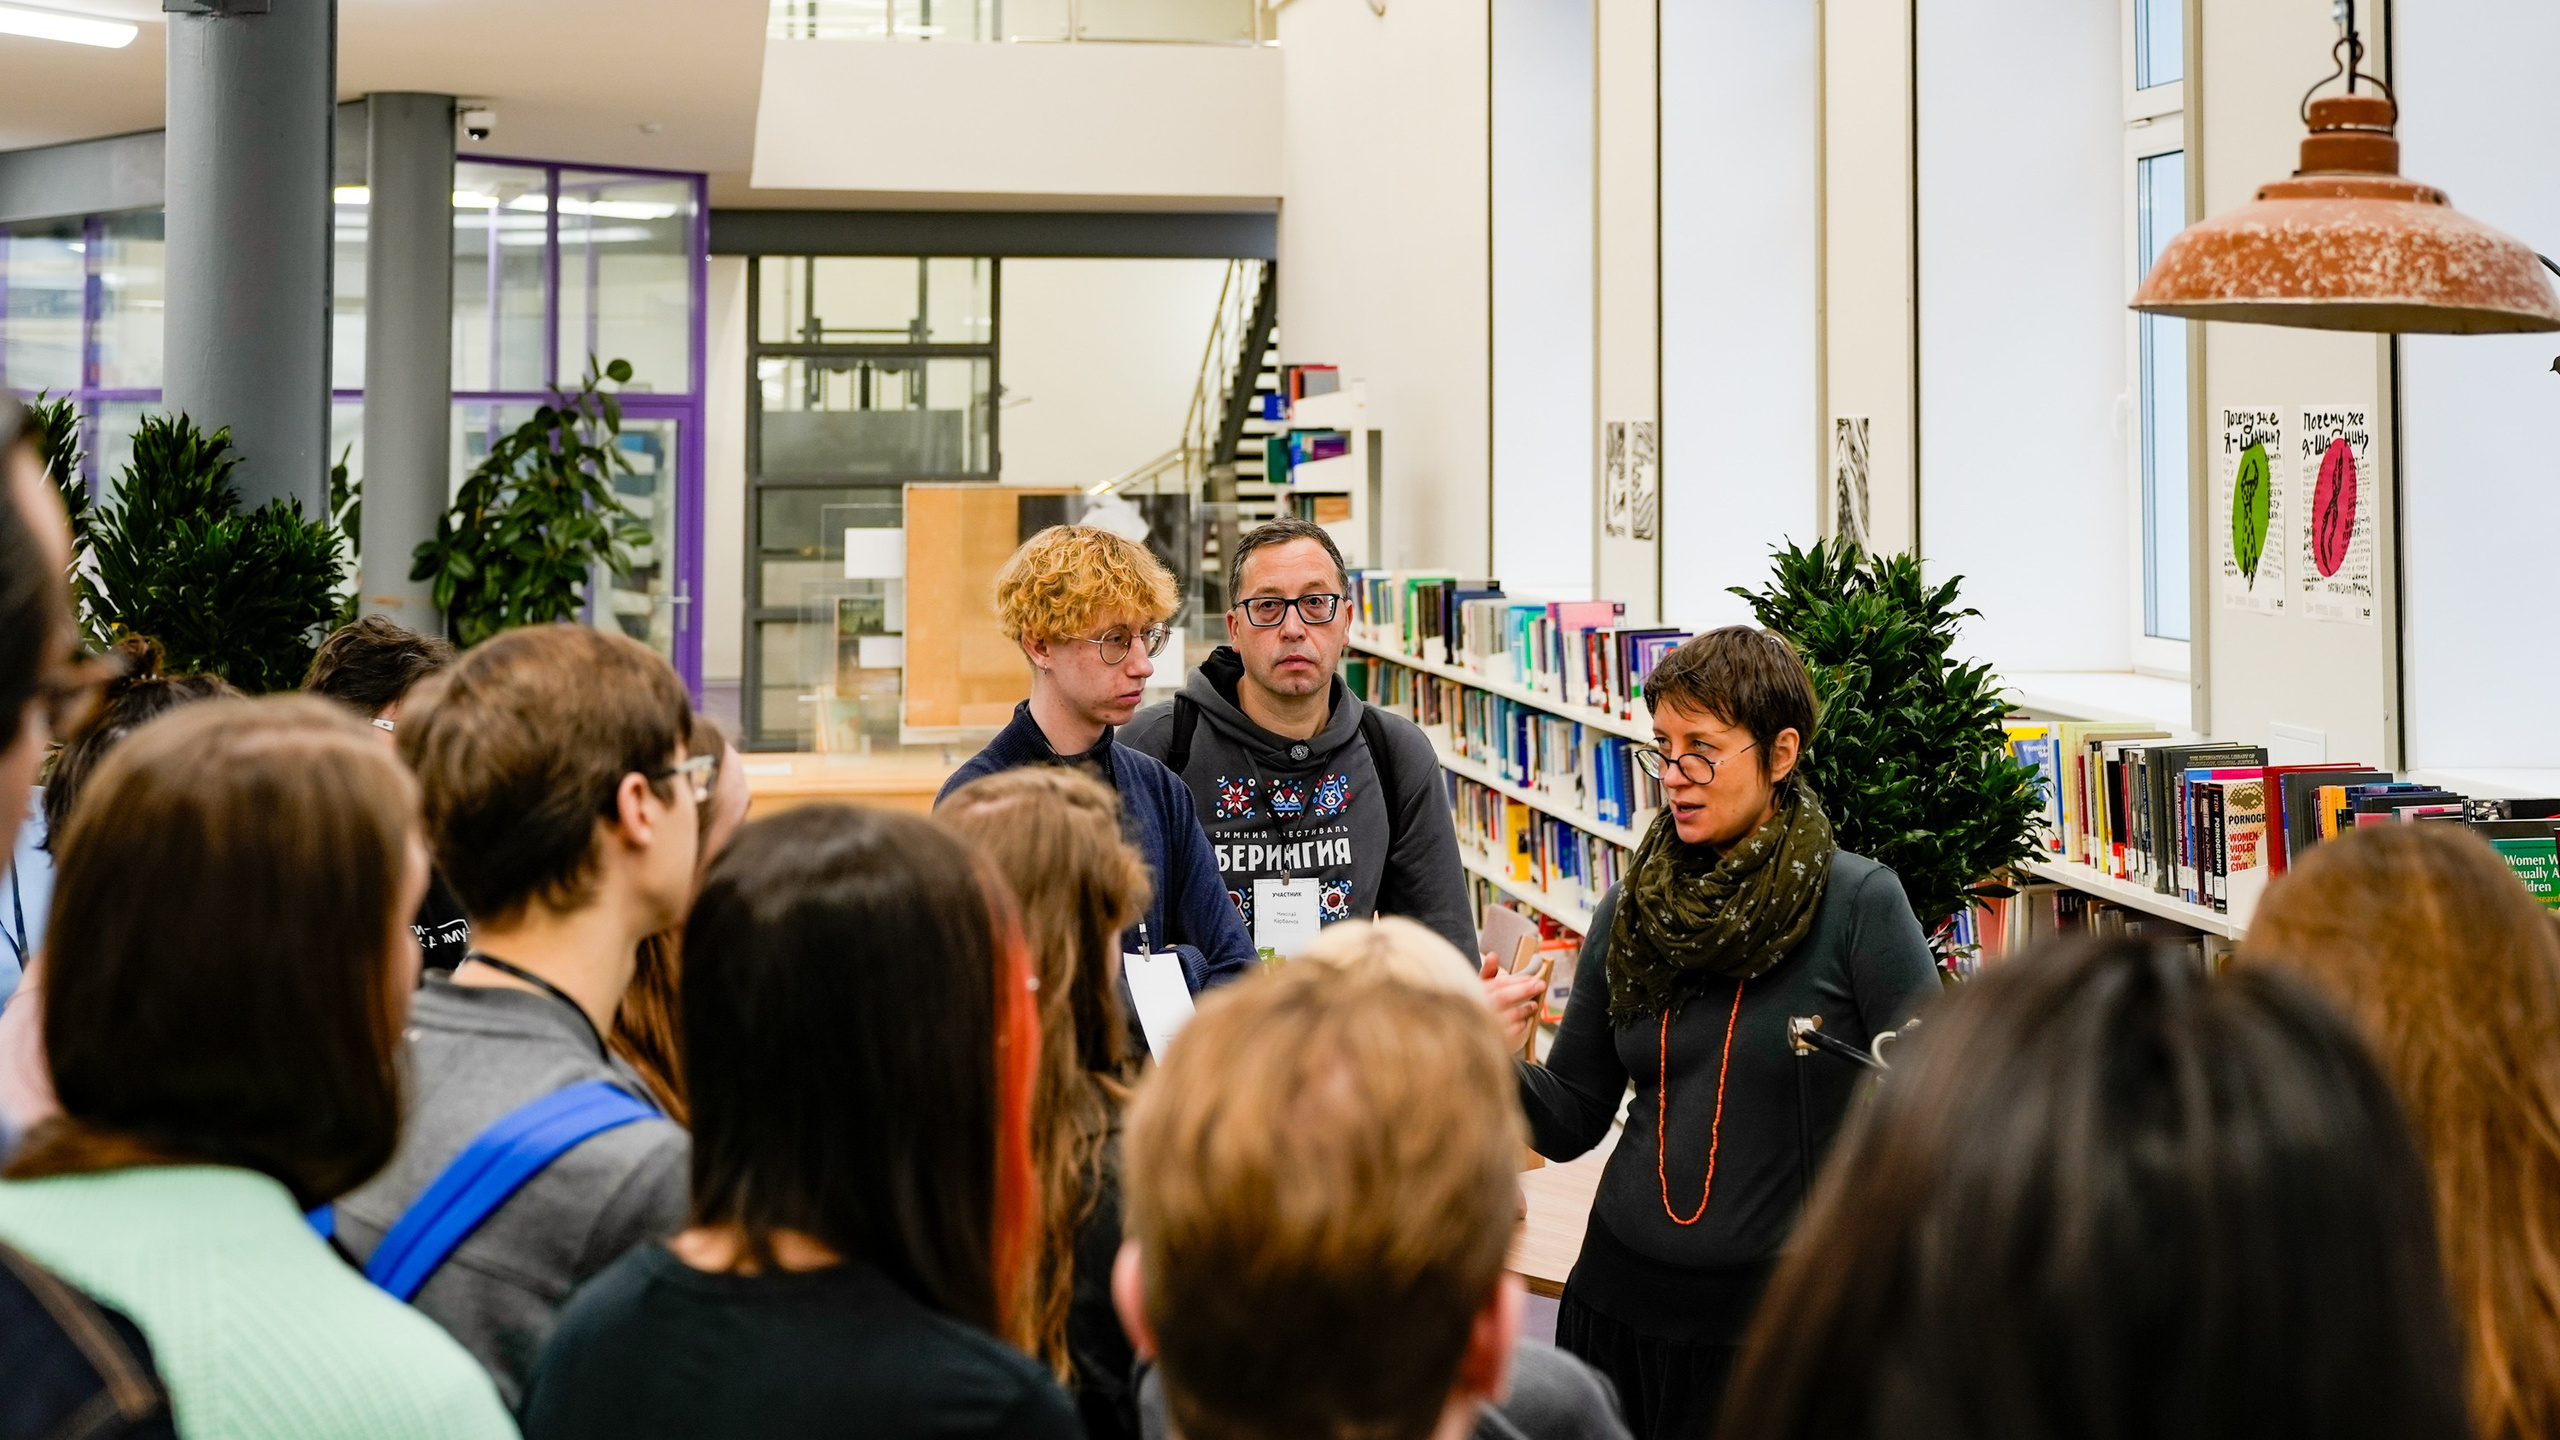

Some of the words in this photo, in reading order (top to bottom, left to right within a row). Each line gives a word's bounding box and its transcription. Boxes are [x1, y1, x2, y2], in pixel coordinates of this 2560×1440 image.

[2257, 412, 2280, 426] же
[2304, 412, 2344, 435] Почему
[2347, 412, 2364, 426] же
[1215, 830, 1268, 839] ЗИМНИЙ
[1279, 825, 1349, 838] ЕСТИВАЛЬ
[2230, 832, 2258, 842] WOMEN
[2214, 817, 2222, 875] PORNOGRAPHY
[1214, 838, 1352, 872] БЕРИНГИЯ
[2504, 854, 2545, 866] Women
[2508, 867, 2549, 882] exually
[2521, 880, 2552, 892] ildren
